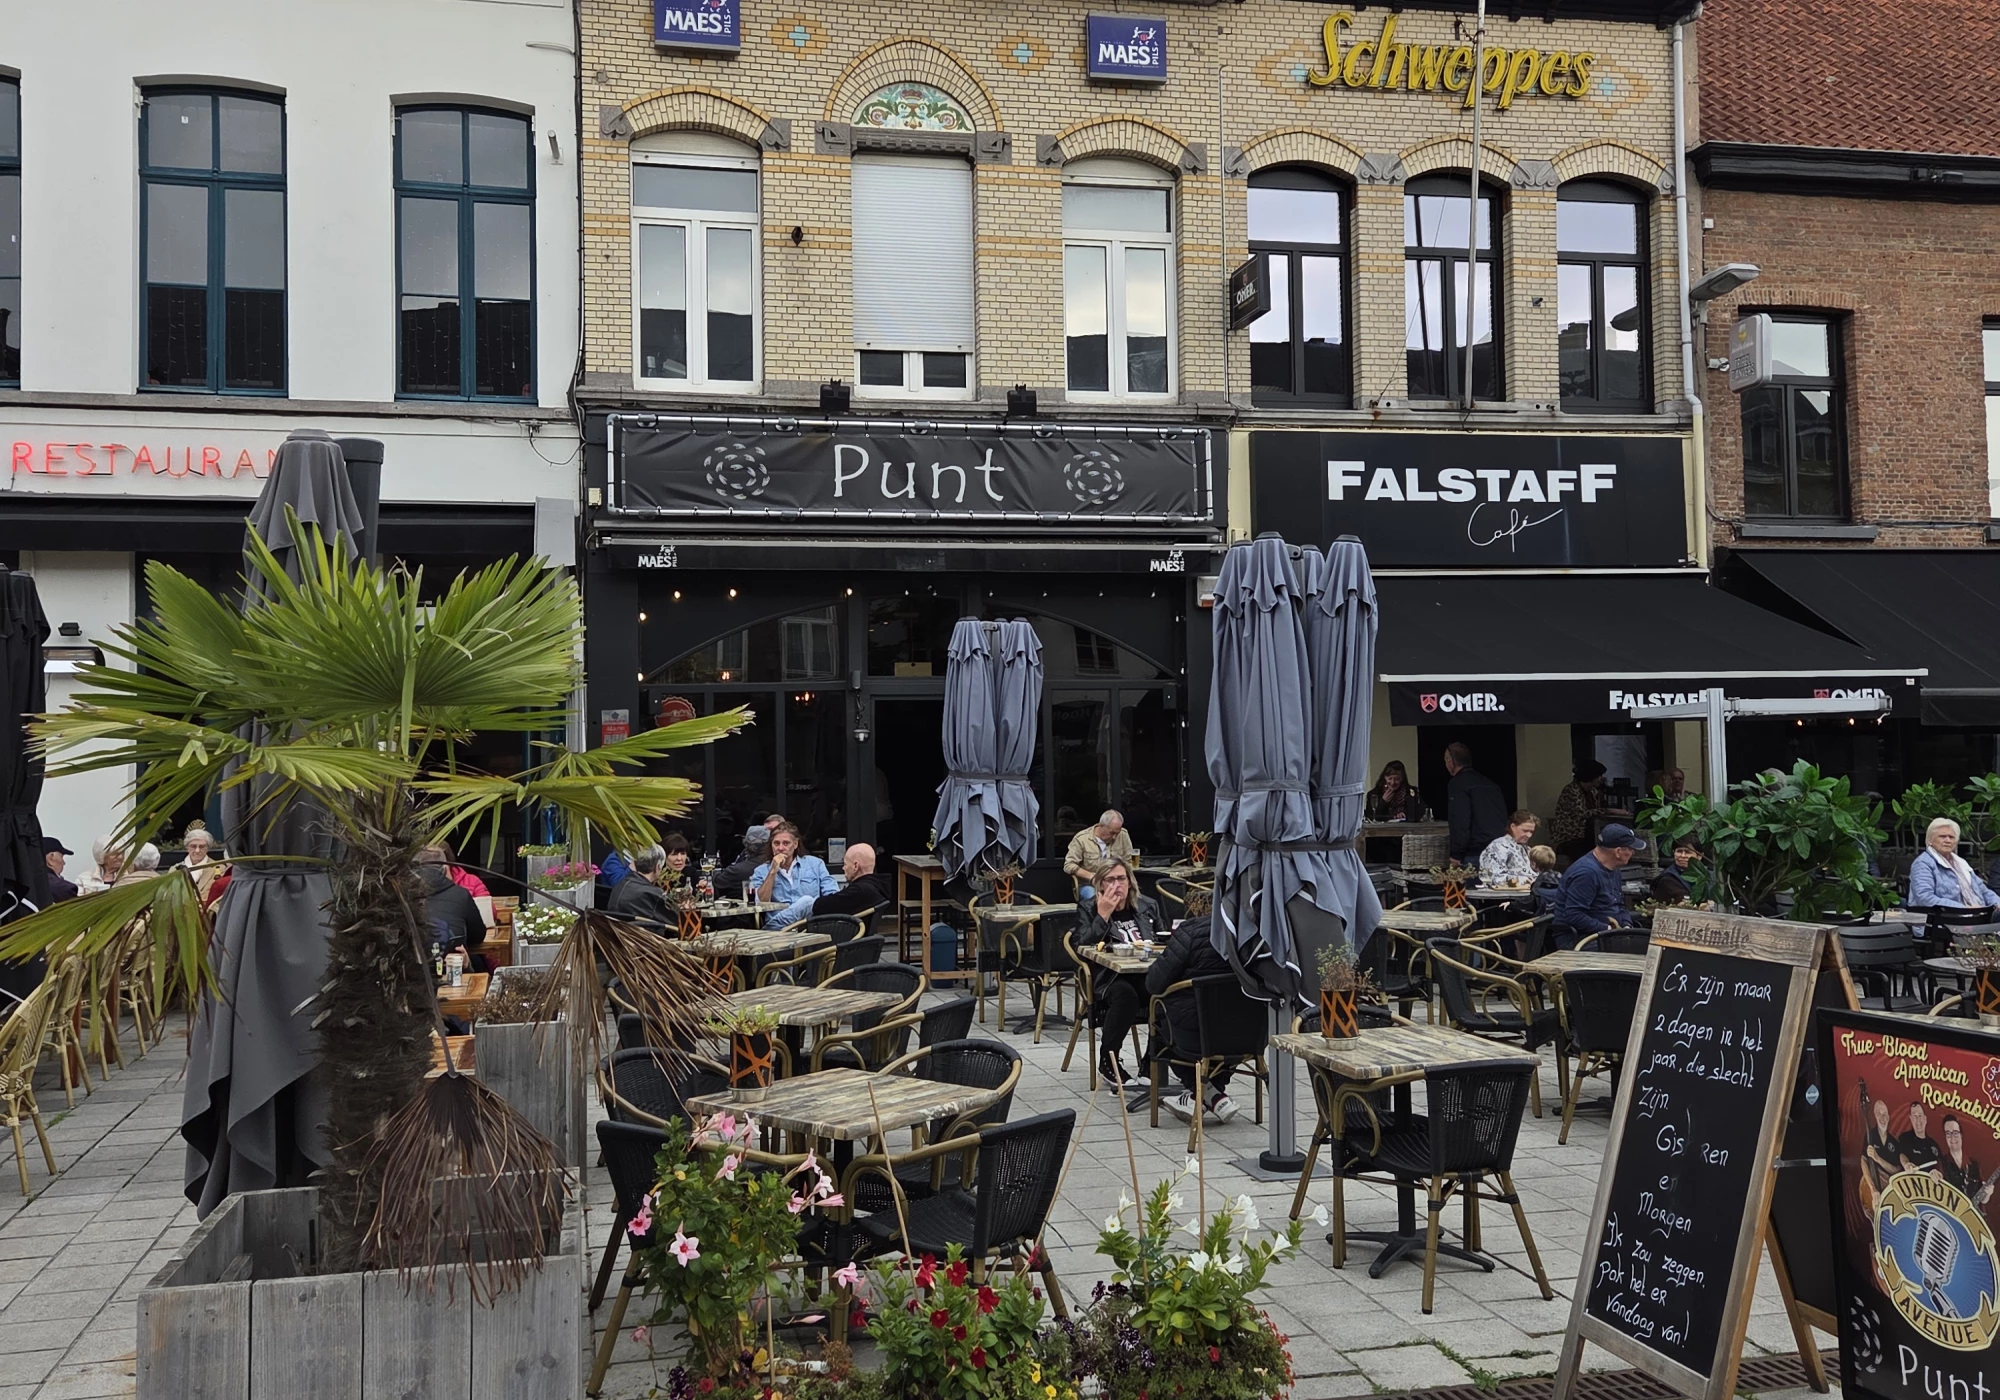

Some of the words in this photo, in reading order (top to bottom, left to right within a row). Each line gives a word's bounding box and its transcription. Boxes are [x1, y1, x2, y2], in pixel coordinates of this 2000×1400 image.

[664, 10, 722, 33] MAES
[723, 14, 731, 34] PILS
[1098, 43, 1151, 66] MAES
[1151, 46, 1159, 65] PILS
[1308, 11, 1595, 109] Schweppes
[833, 444, 1005, 503] Punt
[1327, 460, 1617, 503] FALSTAFF
[637, 555, 672, 568] MAES
[1149, 560, 1180, 572] MAES
[1439, 693, 1506, 713] OMER.
[1654, 1014, 1666, 1032] 2
[1667, 1006, 1715, 1049] dagen
[1685, 1050, 1706, 1077] die
[1893, 1058, 1969, 1088] American
[1896, 1177, 1961, 1213] UNION
[1900, 1299, 1979, 1345] AVENUE
